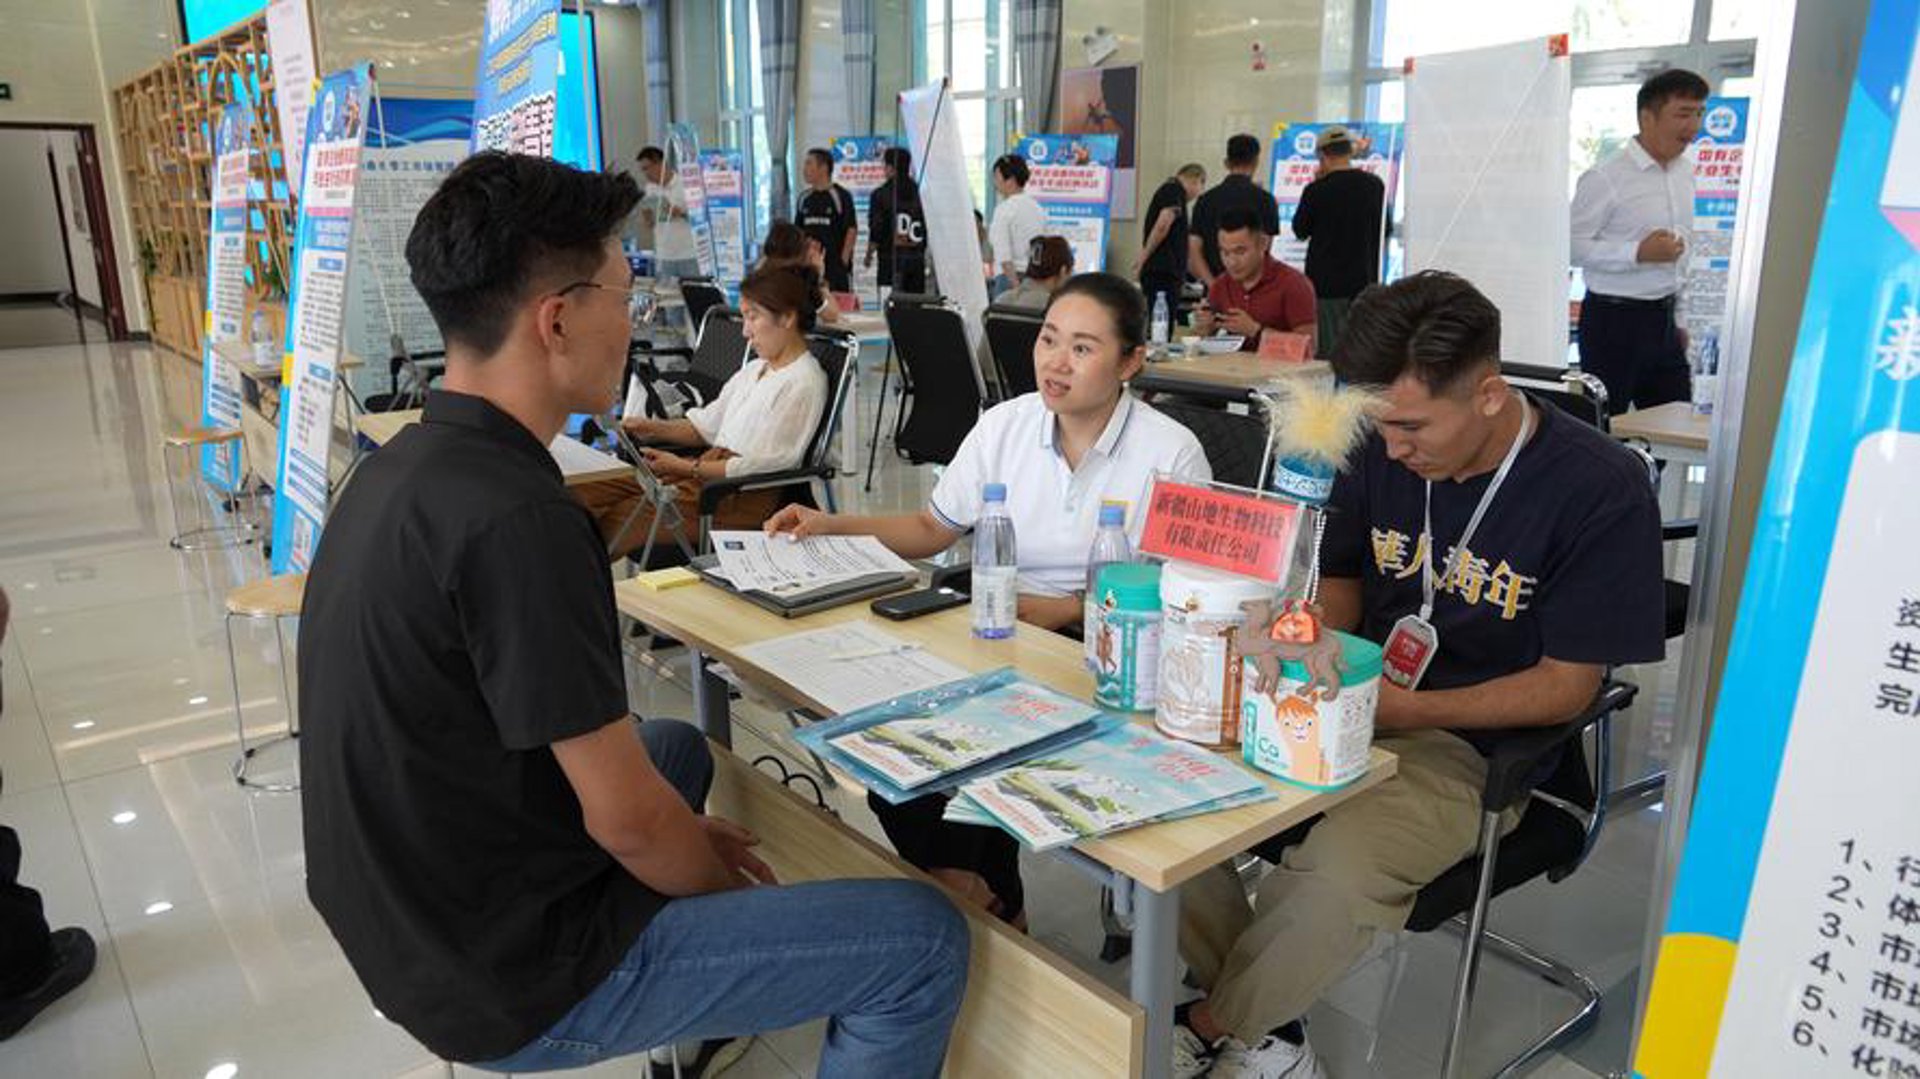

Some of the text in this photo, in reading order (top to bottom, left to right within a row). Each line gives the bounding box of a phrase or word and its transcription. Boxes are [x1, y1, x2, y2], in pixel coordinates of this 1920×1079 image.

[1155, 491, 1287, 540] 新疆山地生物科技
[1164, 521, 1262, 566] 有限责任公司
[1883, 641, 1920, 674] 生
[1873, 682, 1920, 717] 完
[1258, 737, 1280, 758] Ca
[1818, 911, 1920, 968] 3、市
